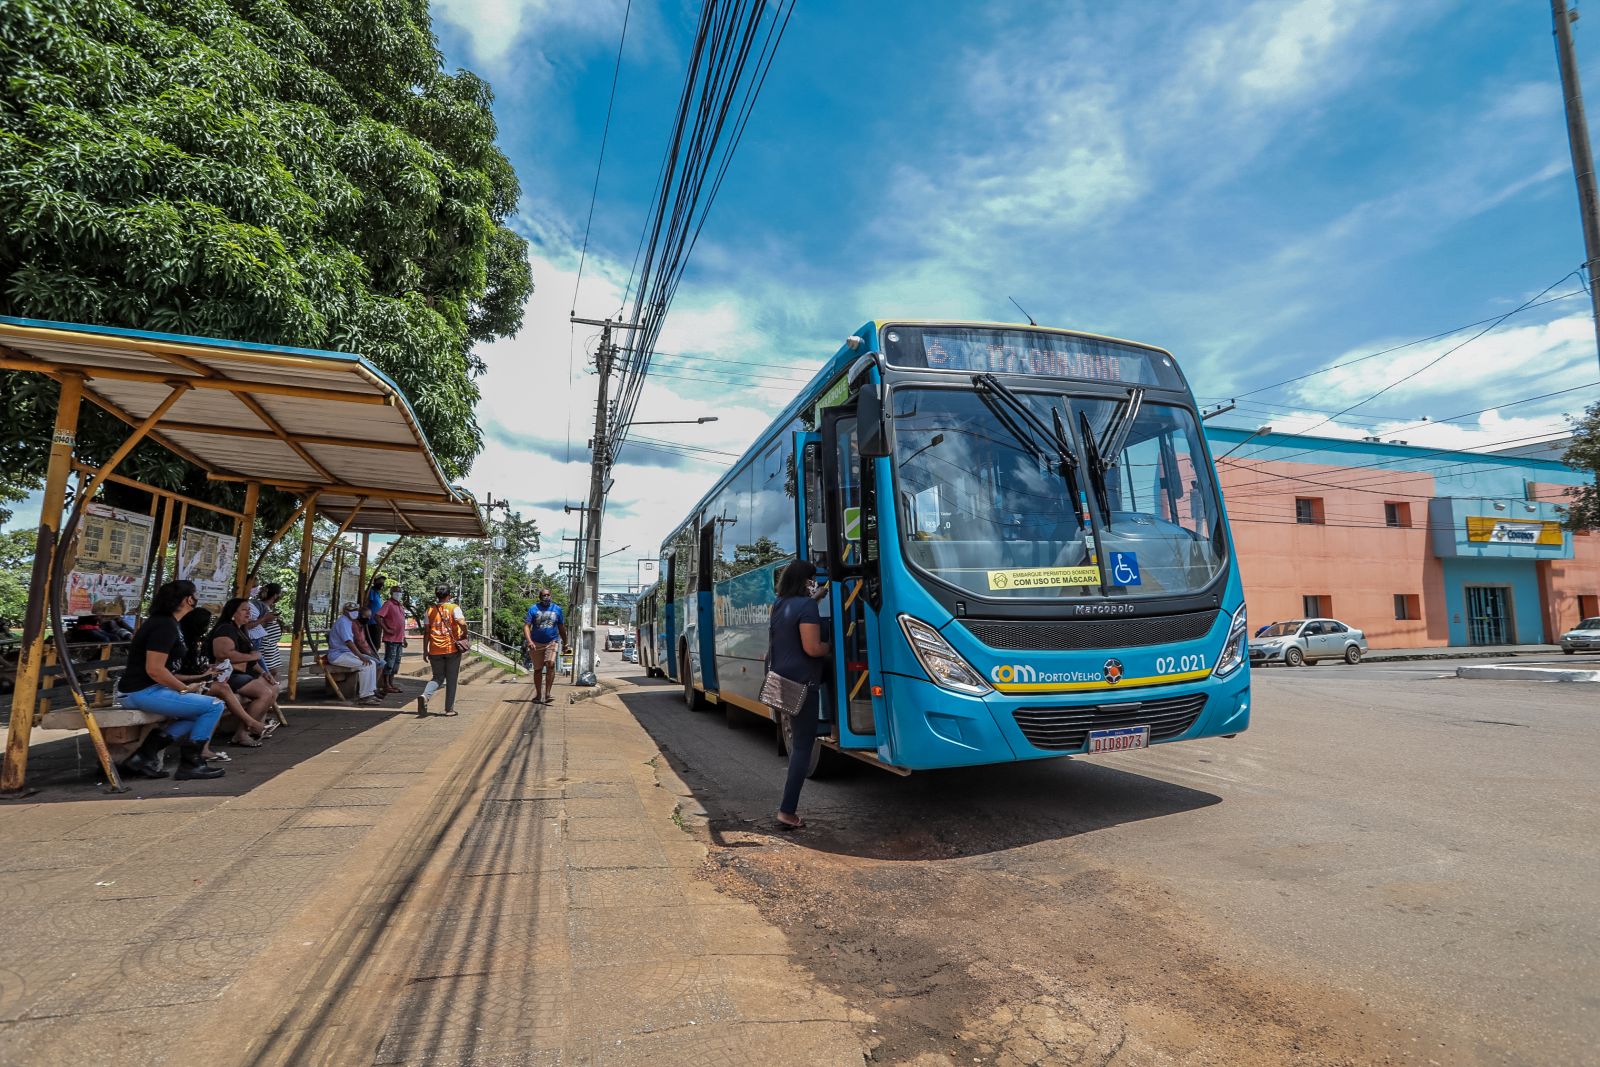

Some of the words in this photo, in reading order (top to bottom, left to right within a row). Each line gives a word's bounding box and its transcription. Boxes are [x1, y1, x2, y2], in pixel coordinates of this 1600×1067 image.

[1013, 578, 1032, 586] COM
[1033, 577, 1050, 585] USO
[1062, 575, 1098, 584] MÁSCARA
[1074, 604, 1135, 615] Marcopolo
[1156, 654, 1205, 673] 02.021
